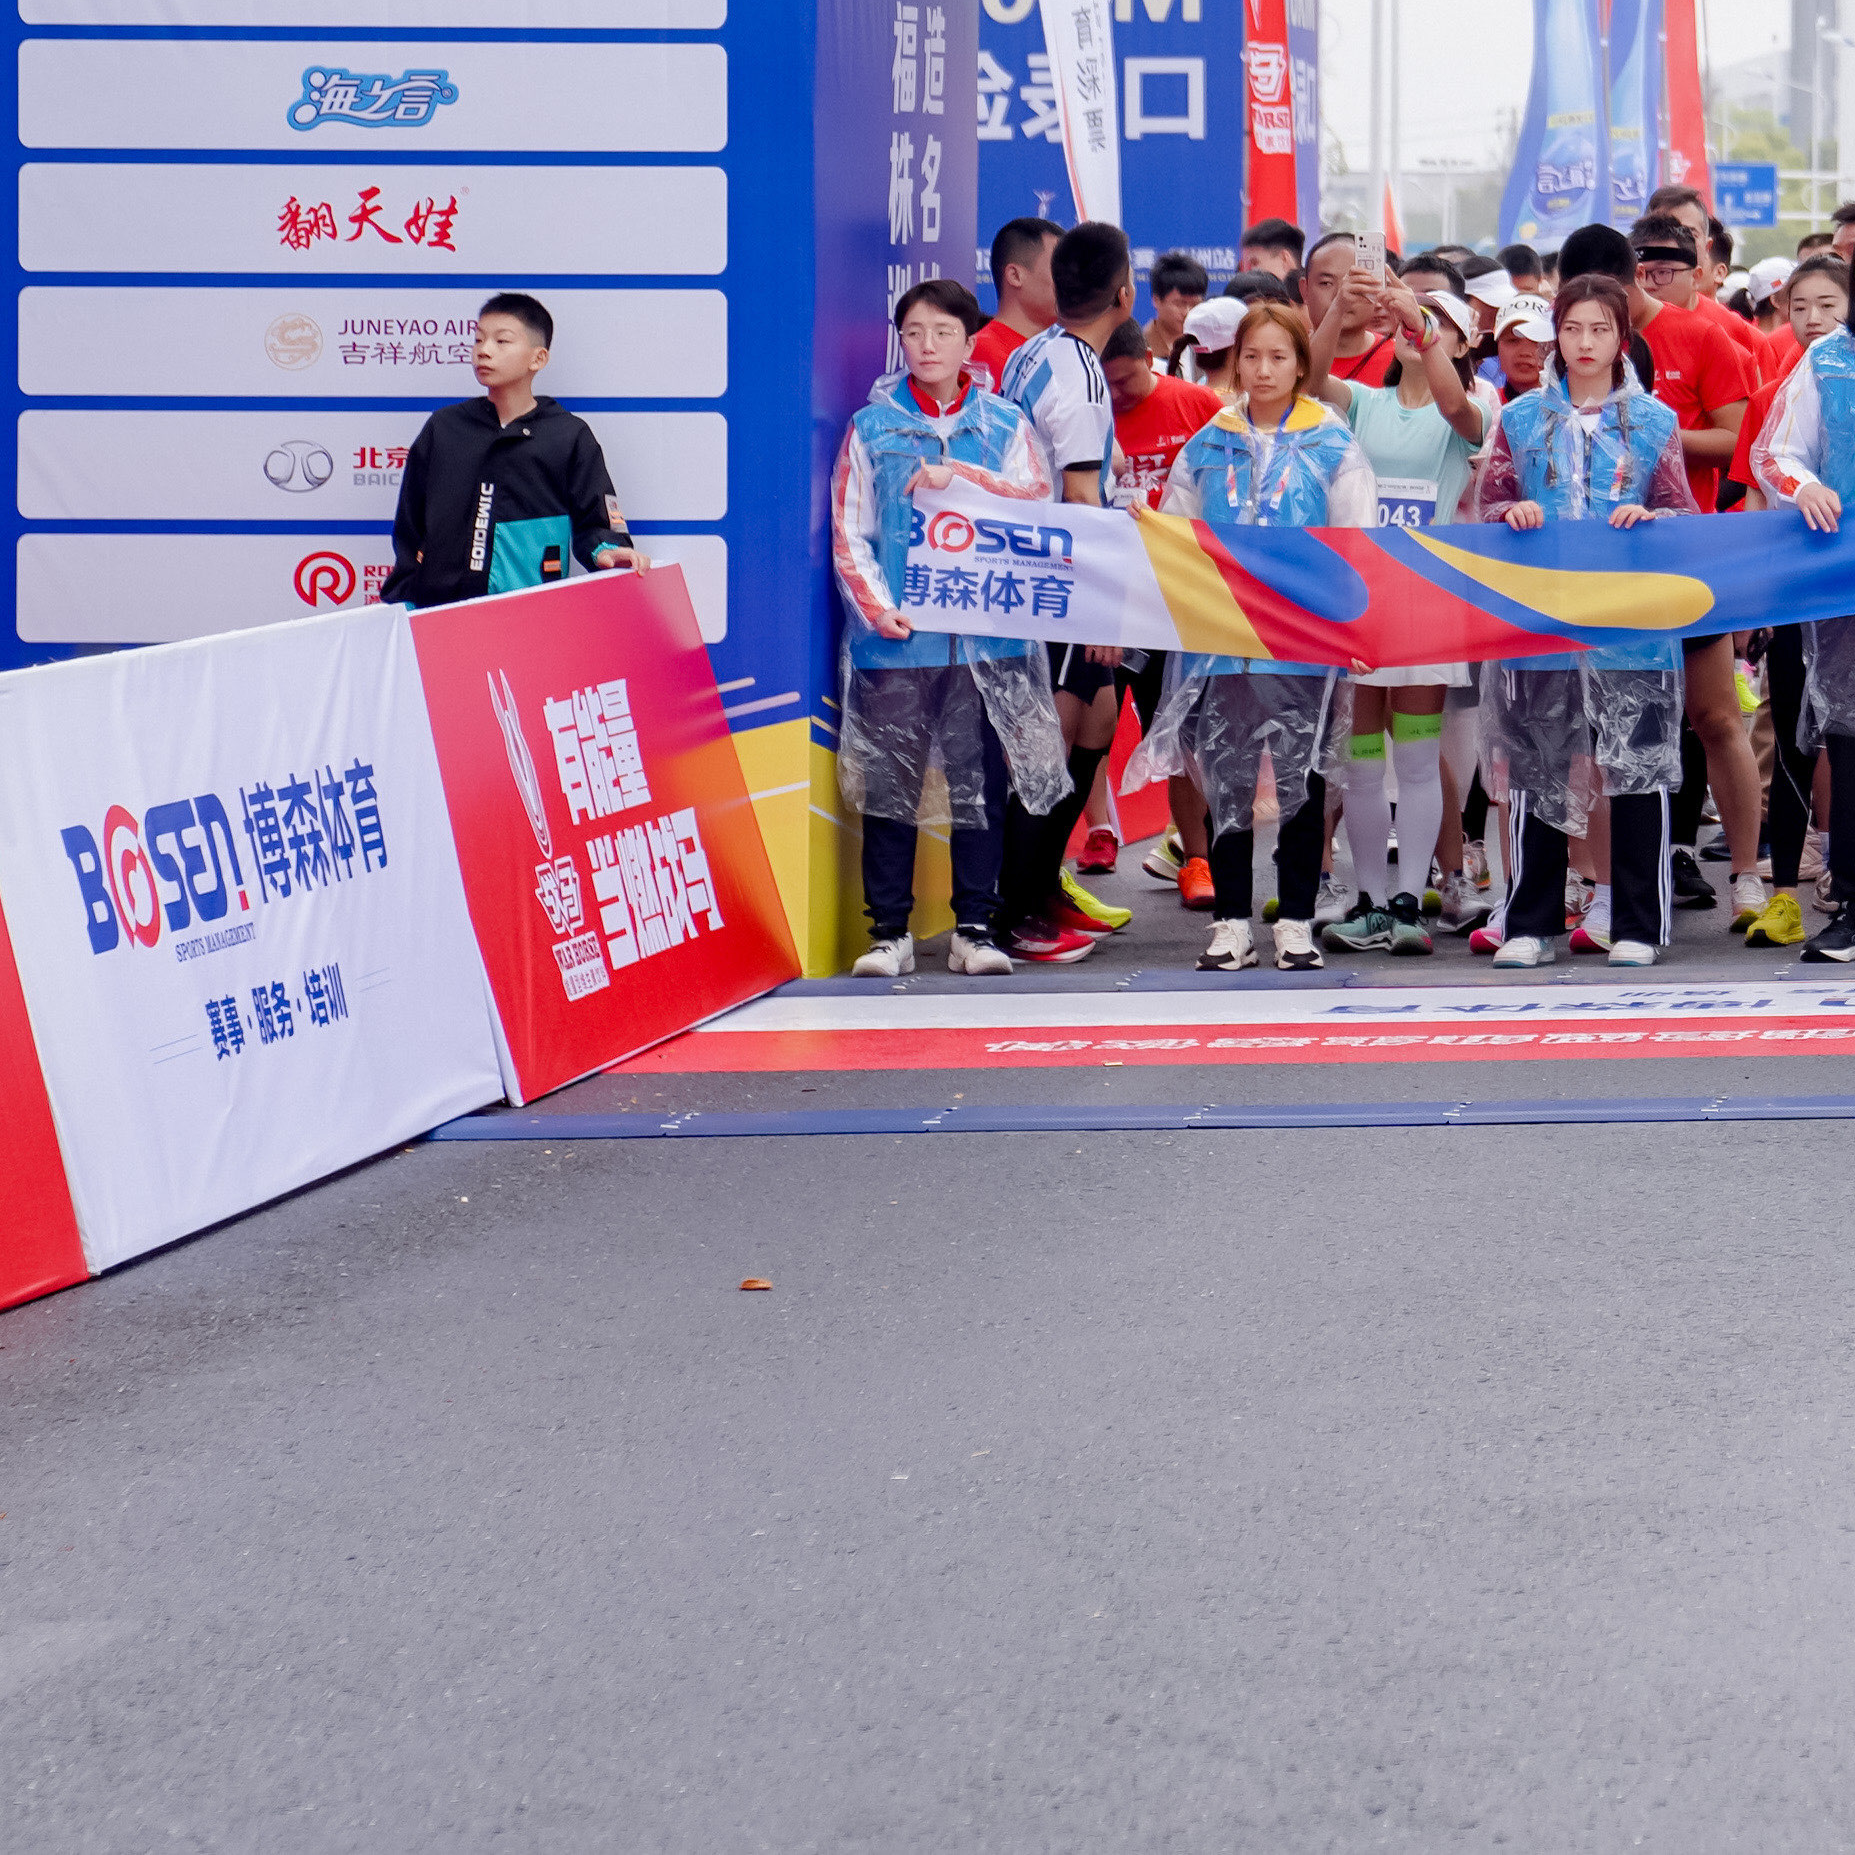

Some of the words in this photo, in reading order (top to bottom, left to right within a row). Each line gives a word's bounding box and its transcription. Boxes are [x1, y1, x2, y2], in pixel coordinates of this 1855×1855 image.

[278, 185, 460, 253] 翻天娃
[338, 319, 439, 336] JUNEYAO
[974, 556, 1010, 566] SPORTS
[543, 678, 654, 826] 有能量
[60, 793, 251, 955] BOSEN
[239, 758, 390, 906] 博森体育
[586, 806, 726, 971] 当燃战马
